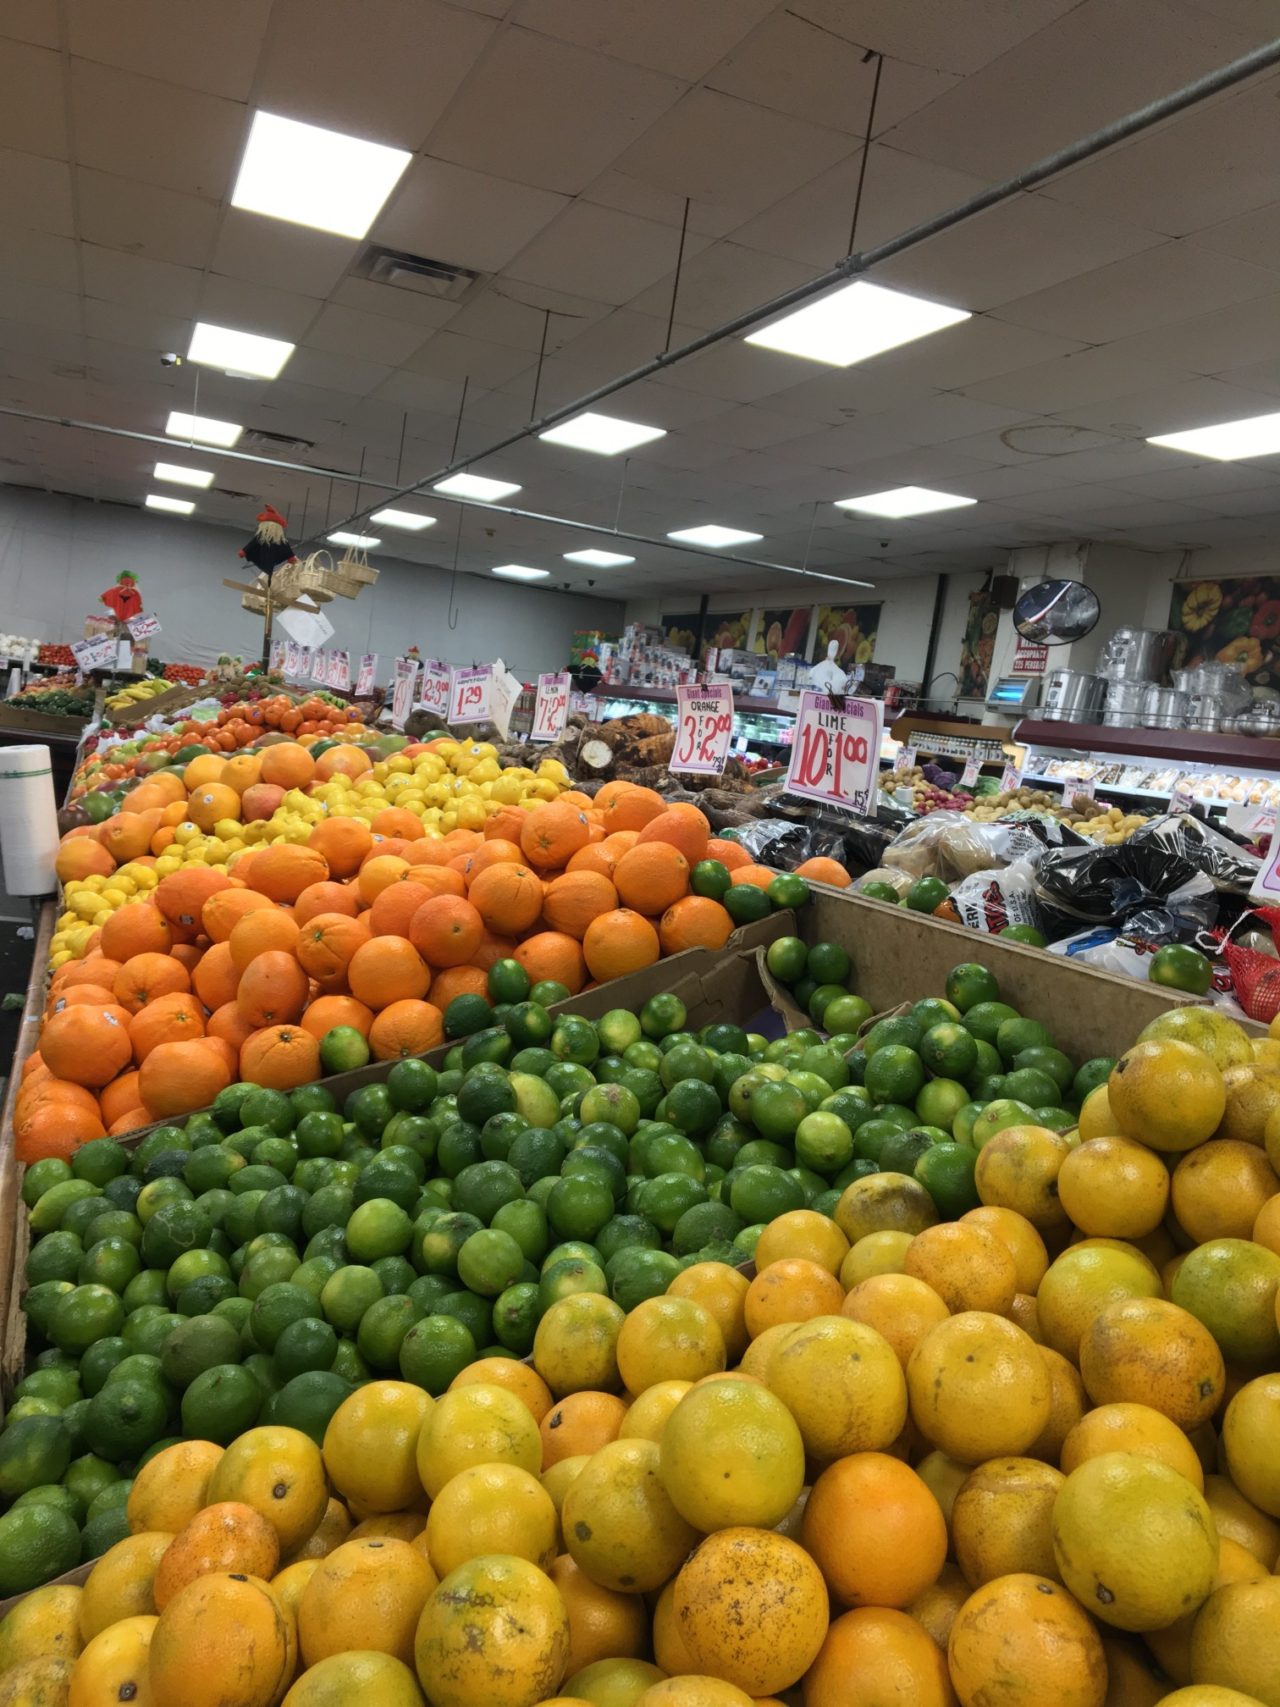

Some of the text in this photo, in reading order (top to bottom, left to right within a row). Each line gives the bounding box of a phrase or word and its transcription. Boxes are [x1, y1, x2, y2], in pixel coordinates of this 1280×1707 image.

[690, 701, 720, 713] ORANGE
[818, 712, 847, 732] LIME
[679, 715, 696, 763] 3
[792, 723, 829, 786] 10
